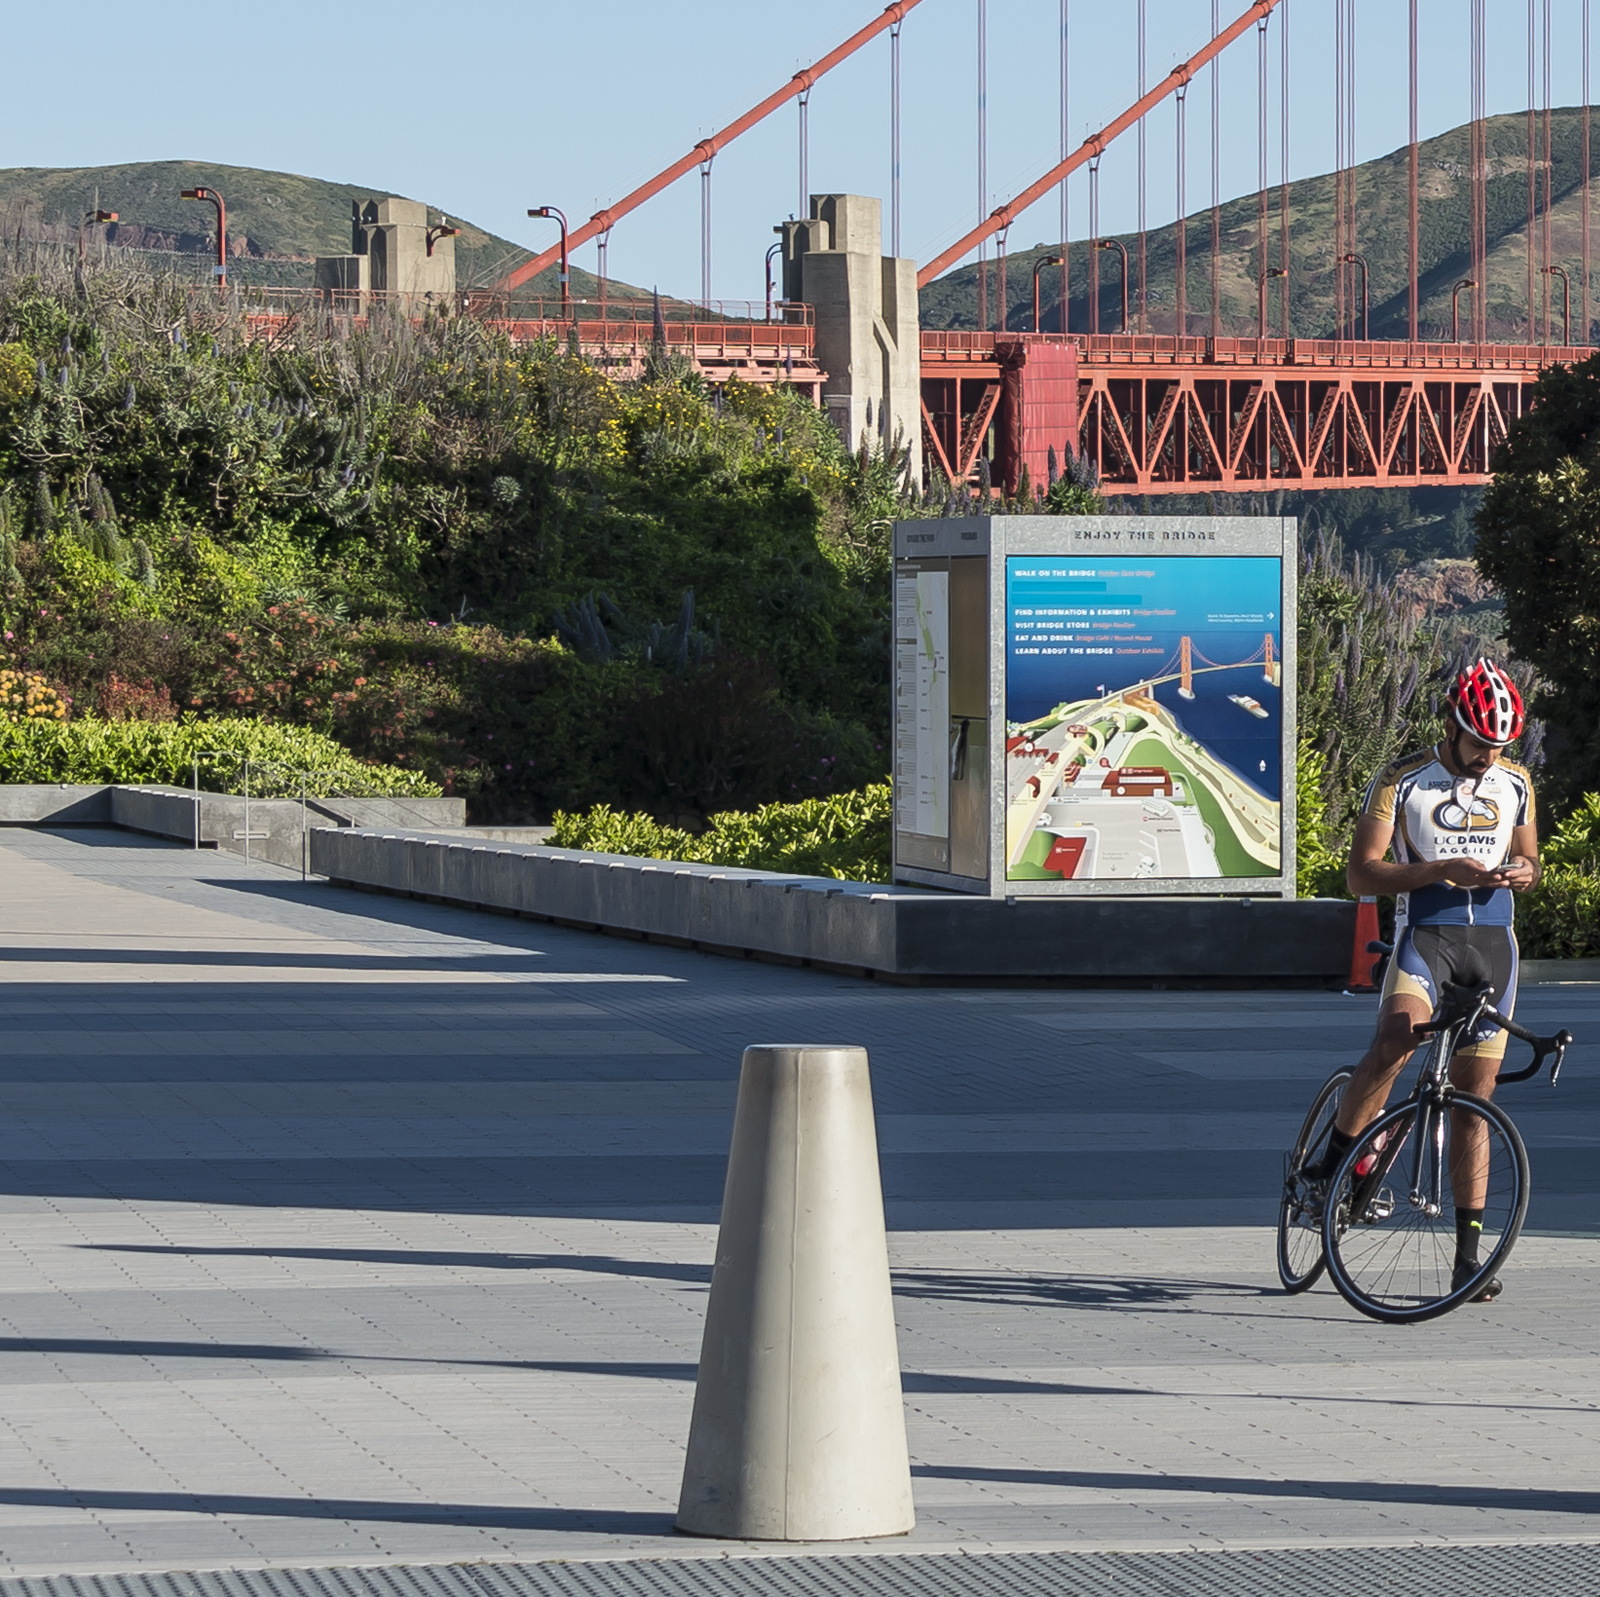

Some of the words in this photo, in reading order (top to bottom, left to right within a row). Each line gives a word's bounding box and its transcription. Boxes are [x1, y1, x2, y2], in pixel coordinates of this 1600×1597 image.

[1074, 530, 1121, 540] ENJOY
[1128, 530, 1155, 540] THE
[1162, 530, 1216, 540] BRIDGE
